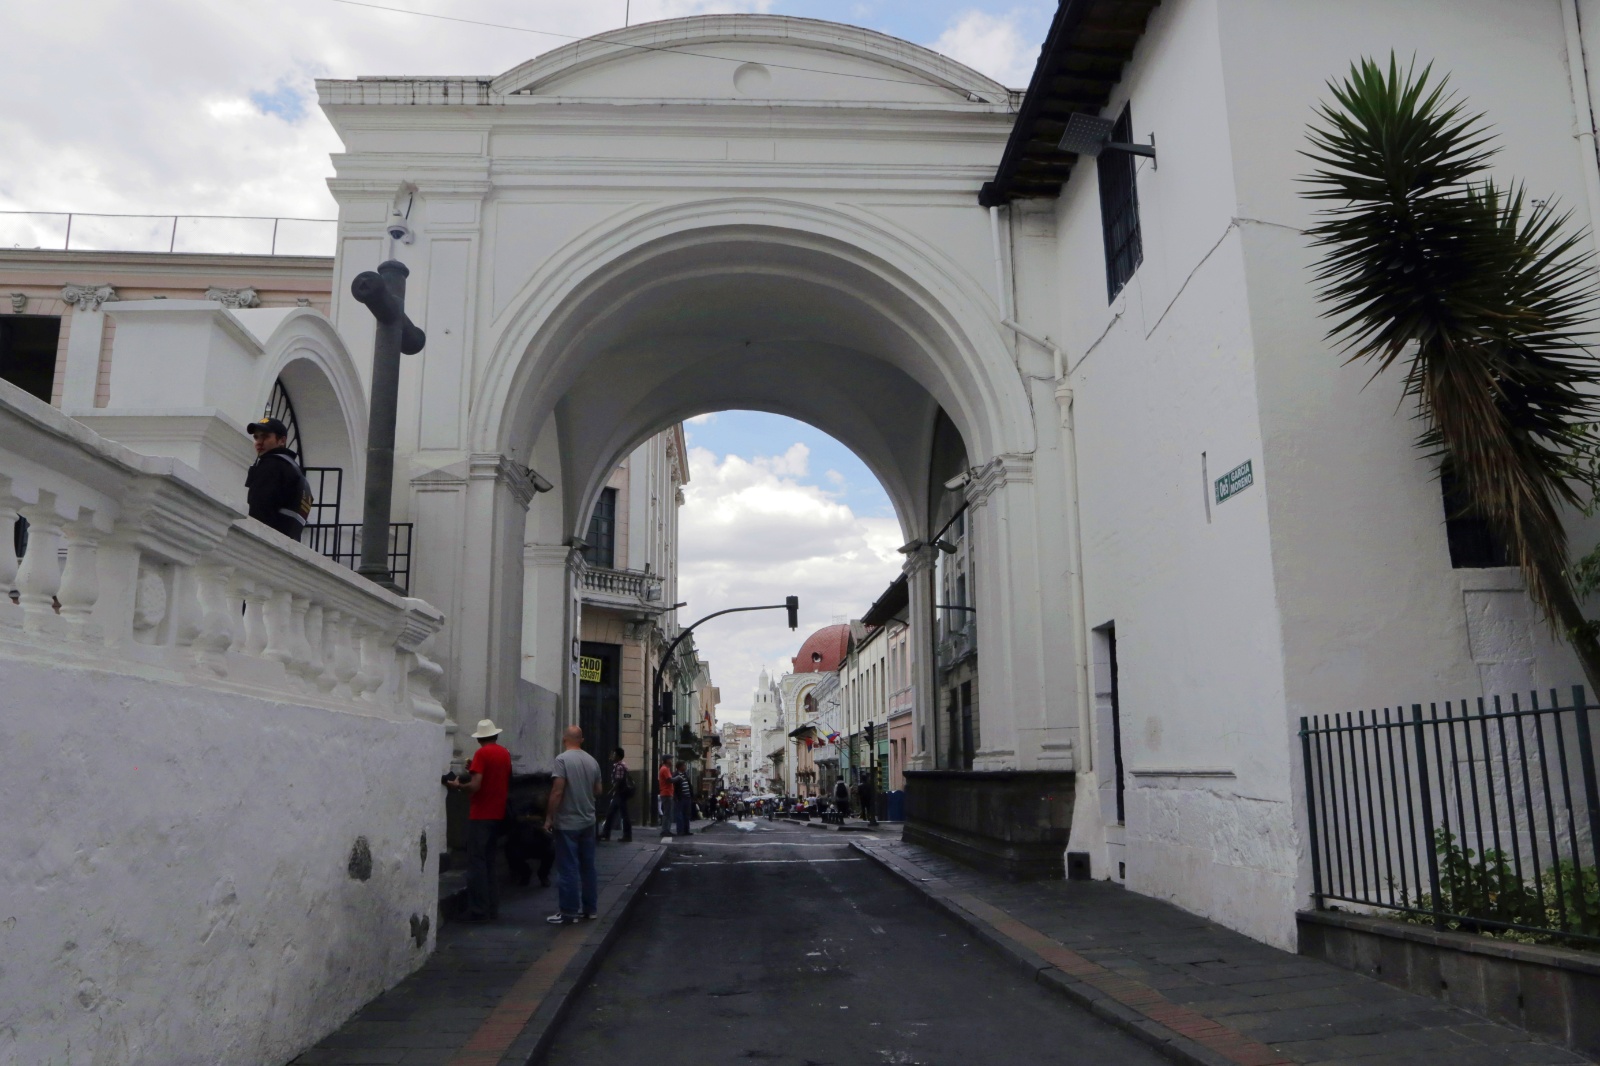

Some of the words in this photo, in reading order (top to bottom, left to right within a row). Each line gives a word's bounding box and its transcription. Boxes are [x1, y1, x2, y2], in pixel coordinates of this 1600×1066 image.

[1230, 463, 1250, 482] GARCIA
[1230, 473, 1252, 493] MORENO
[580, 657, 600, 672] ENDO
